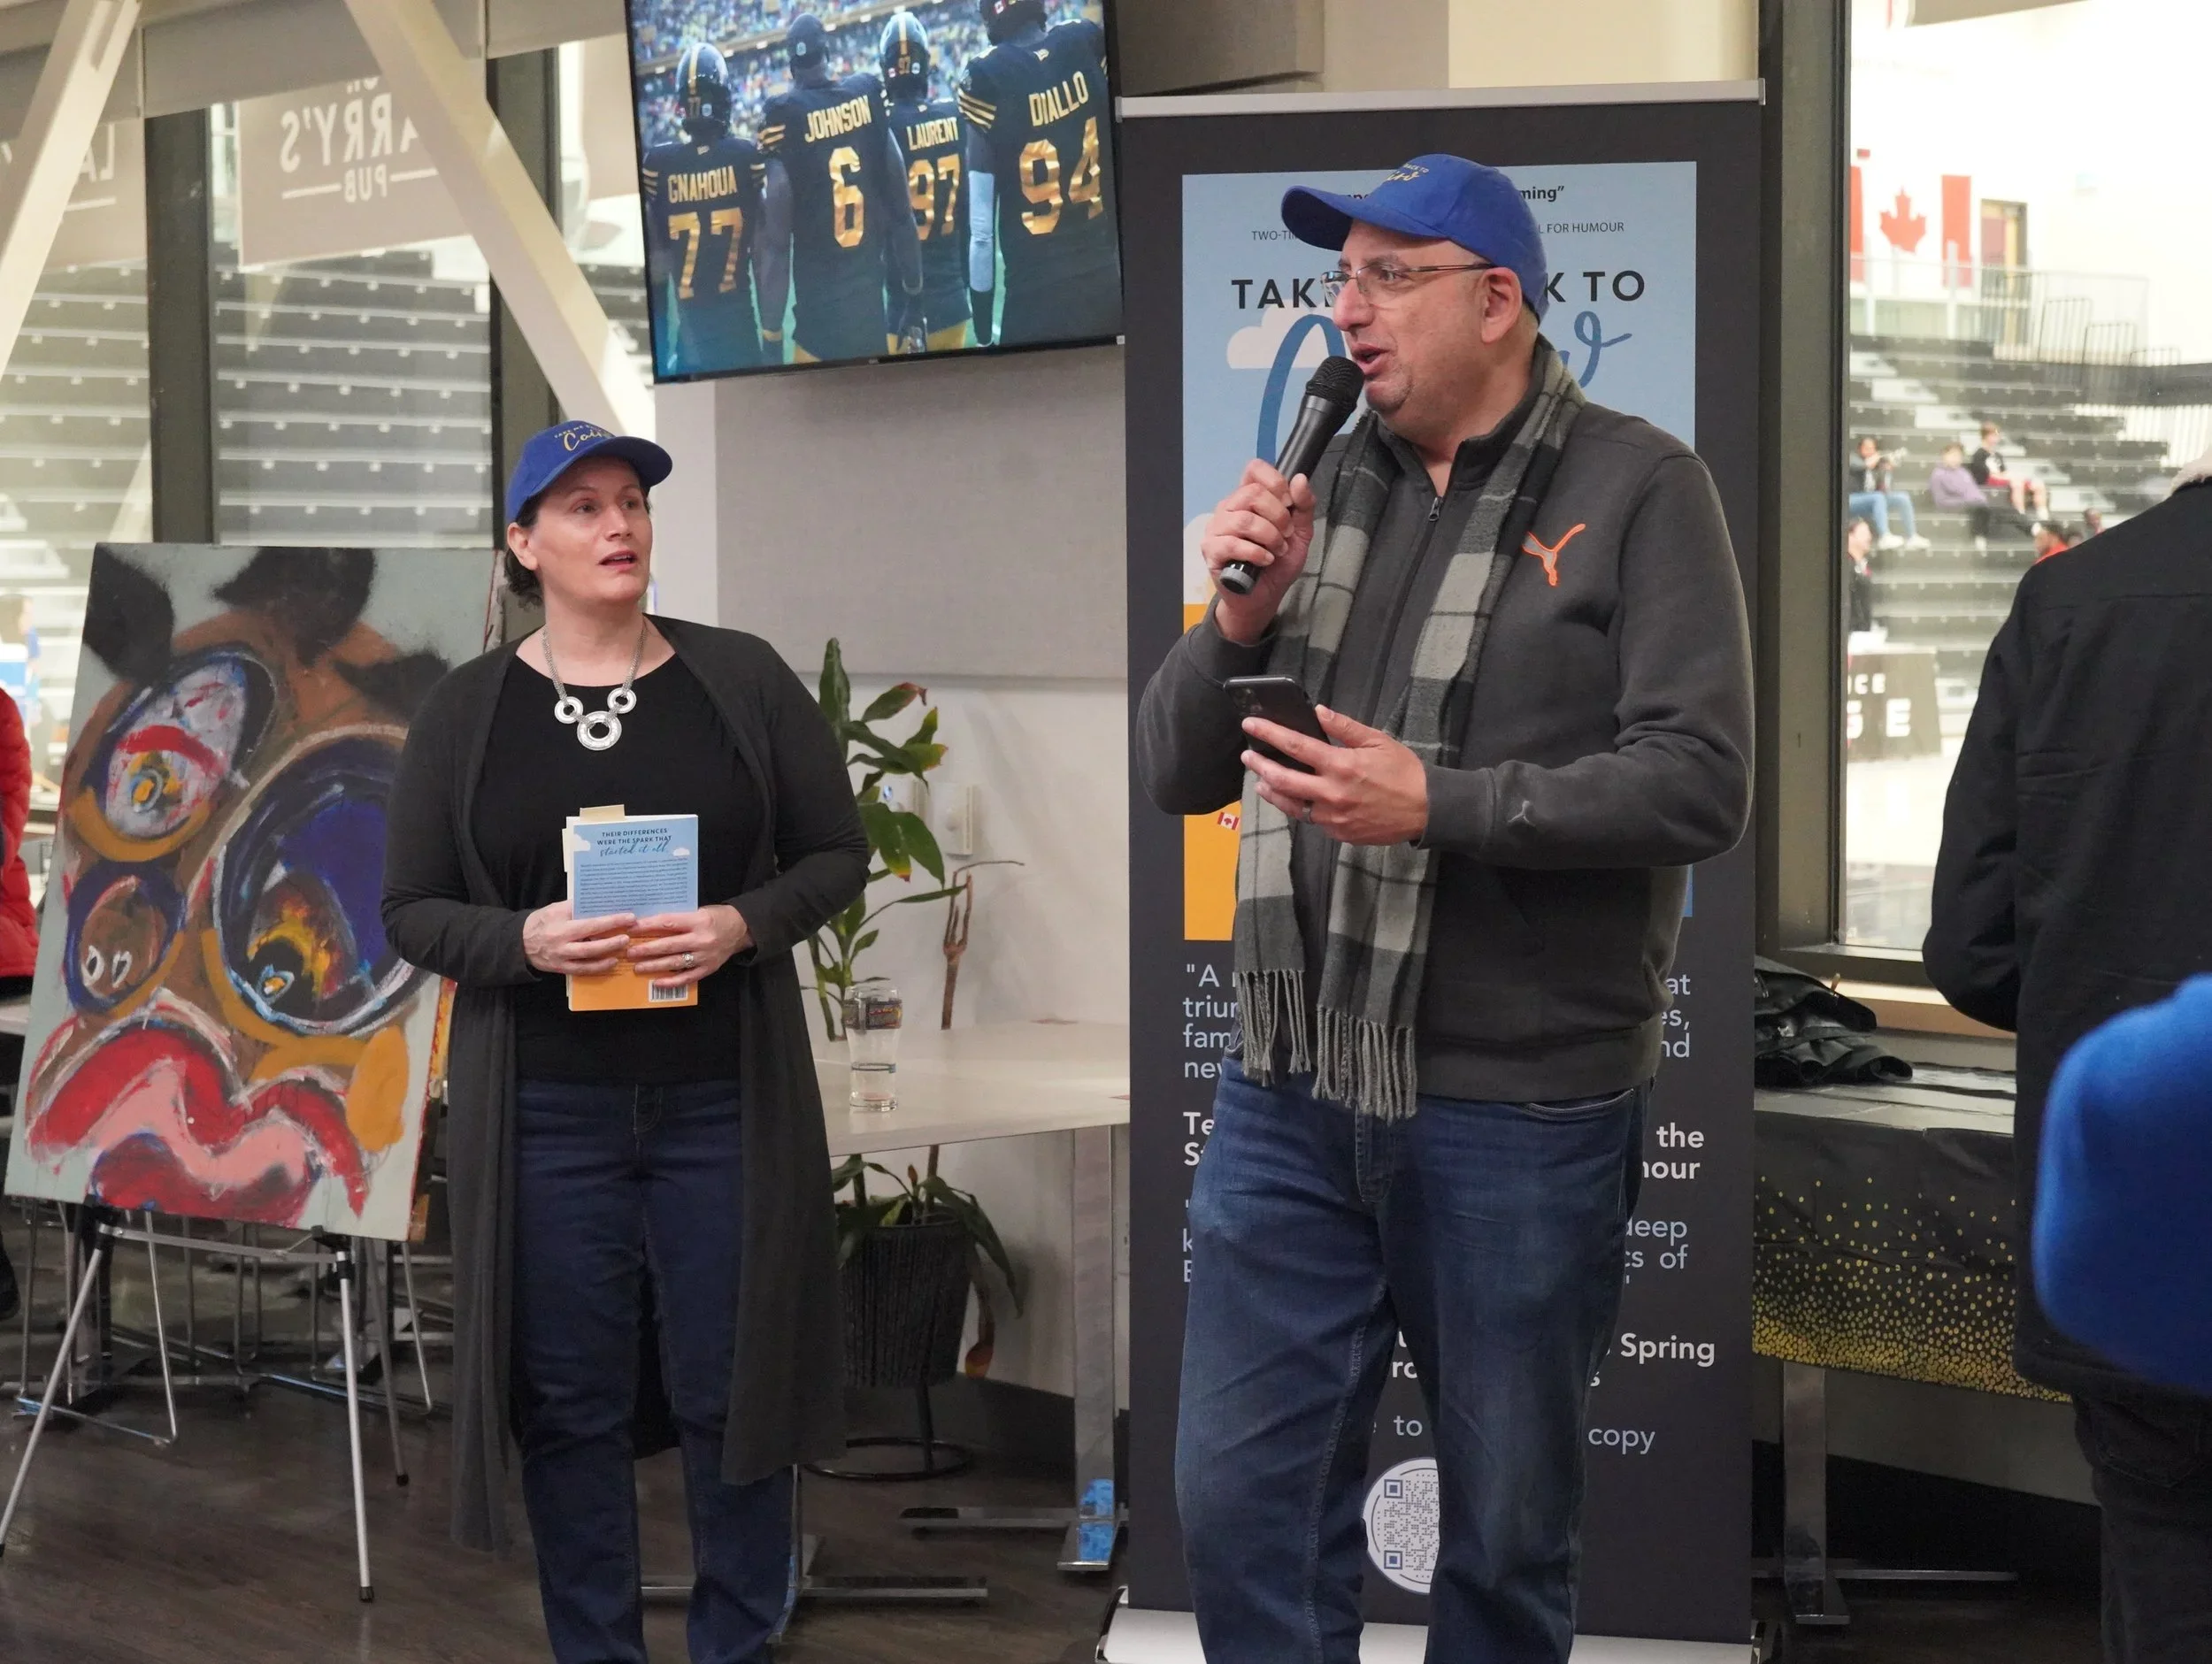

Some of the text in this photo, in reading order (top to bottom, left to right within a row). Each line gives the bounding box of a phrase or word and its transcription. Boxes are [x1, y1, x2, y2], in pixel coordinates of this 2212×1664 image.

[1029, 71, 1089, 127] DIALLO
[804, 95, 872, 143] JOHNSON
[906, 116, 960, 151] LAURENT
[668, 165, 737, 203] GNAHOUA
[1019, 117, 1104, 235] 94
[829, 146, 864, 248] 6
[908, 153, 961, 241] 97
[1547, 223, 1570, 234] FOR
[1572, 221, 1624, 234] HUMOUR
[668, 207, 743, 299] 77
[1582, 270, 1645, 303] TO
[1655, 1122, 1705, 1148] the
[1659, 1244, 1689, 1269] of
[1620, 1332, 1716, 1368] Spring
[1393, 1415, 1423, 1437] to
[1587, 1428, 1656, 1455] copy
